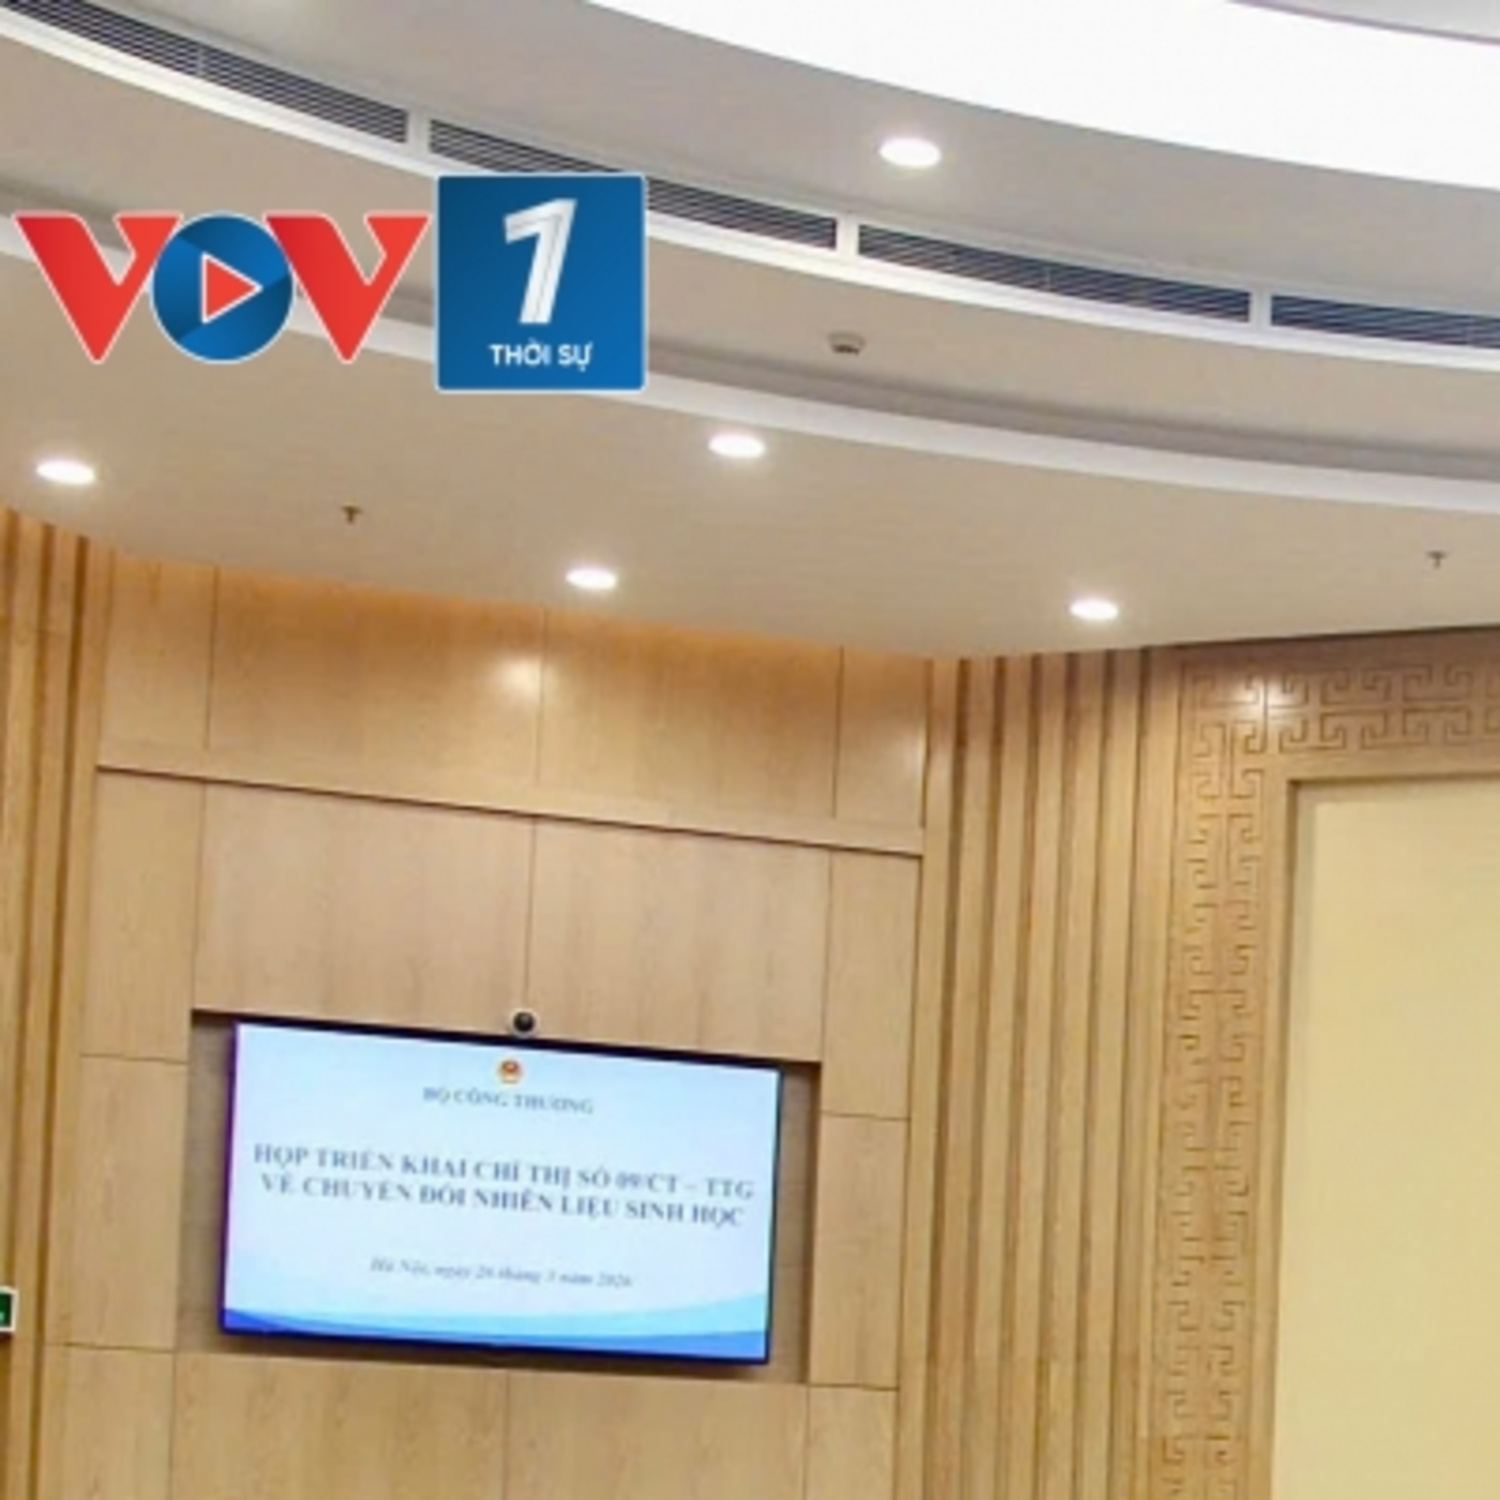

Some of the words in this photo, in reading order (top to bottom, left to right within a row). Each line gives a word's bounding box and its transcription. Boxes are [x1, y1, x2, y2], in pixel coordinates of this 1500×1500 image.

[254, 1143, 308, 1169] HỌP
[401, 1154, 467, 1178] KHAI
[705, 1177, 755, 1201] TTG
[624, 1200, 685, 1223] SINH
